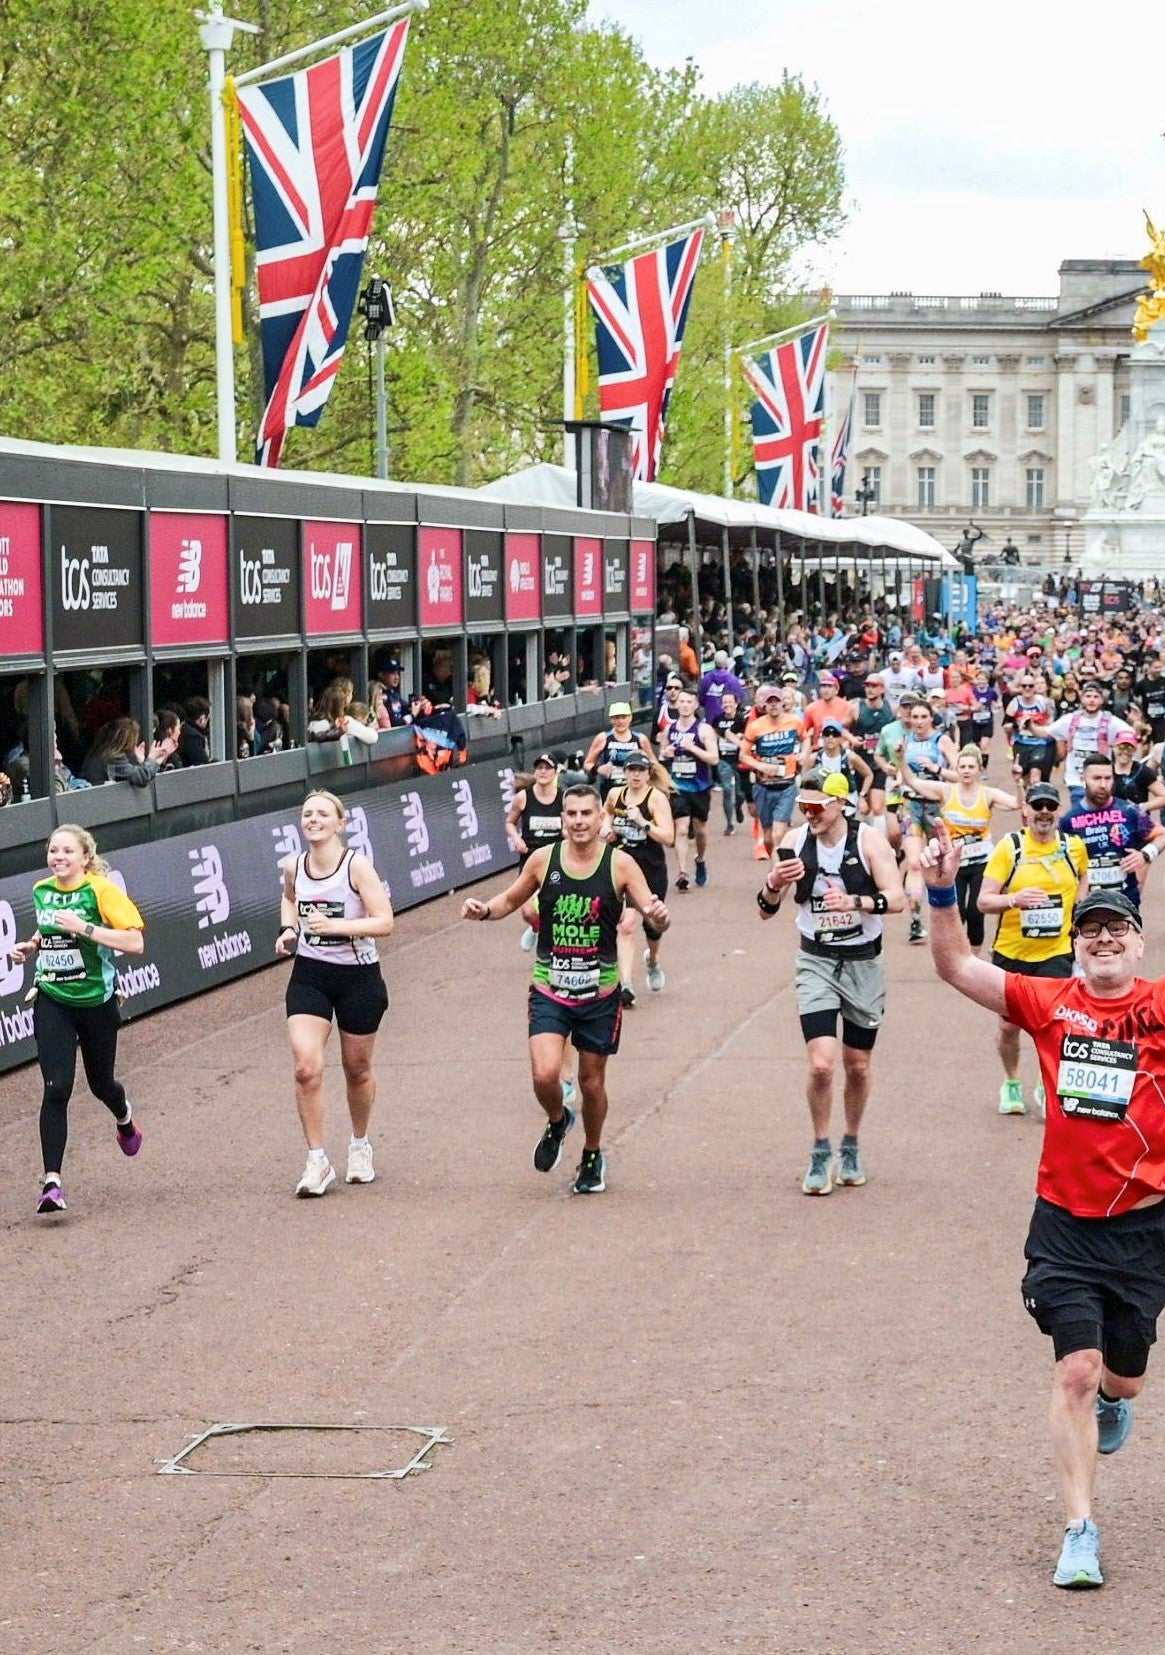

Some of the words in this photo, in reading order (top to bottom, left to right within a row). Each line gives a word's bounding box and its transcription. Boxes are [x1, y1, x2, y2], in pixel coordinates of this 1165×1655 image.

[91, 545, 109, 563] TATA
[61, 544, 90, 610] tcs
[91, 569, 130, 586] CONSULTANCY
[239, 549, 262, 604] tcs
[311, 542, 332, 599] tcs
[370, 552, 387, 600] tcs
[92, 592, 117, 610] SERVICES
[172, 602, 184, 619] new
[183, 599, 207, 619] balance
[1071, 810, 1127, 829] MICHAEL
[552, 924, 600, 938] MOLE
[198, 938, 216, 970] new
[213, 930, 251, 963] balance
[553, 937, 598, 947] VALLEY
[553, 956, 570, 969] tcs
[1063, 1037, 1089, 1059] tcs
[1090, 1047, 1133, 1060] CONSULTANCY
[1092, 1041, 1111, 1050] TATA
[1089, 1054, 1117, 1064] SERVICES
[1066, 1068, 1119, 1093] 58041
[1076, 1106, 1092, 1114] new
[1091, 1107, 1119, 1118] balance
